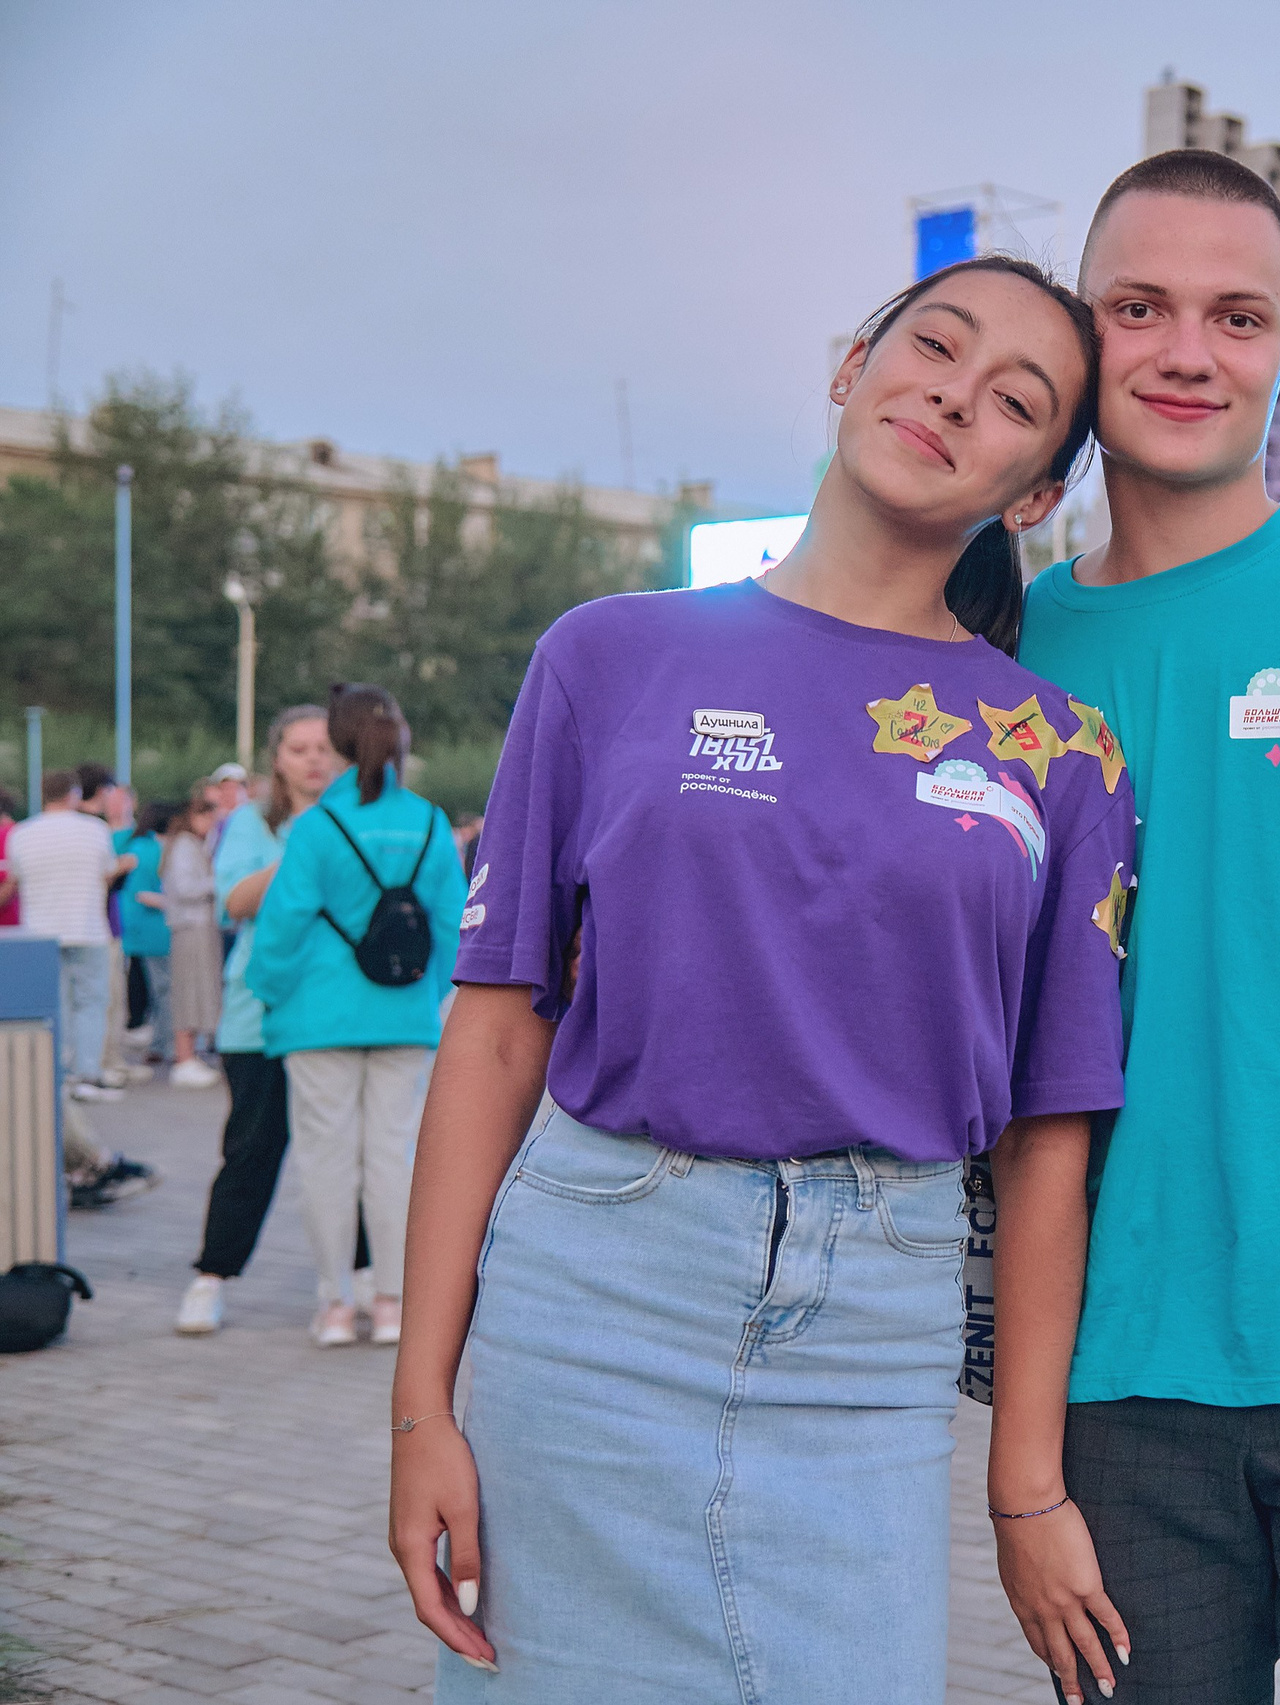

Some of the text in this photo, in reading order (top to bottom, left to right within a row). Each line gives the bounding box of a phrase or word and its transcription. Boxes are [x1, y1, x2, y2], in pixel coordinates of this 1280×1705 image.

[700, 715, 759, 730] Душнила
[681, 773, 731, 784] проект от
[680, 782, 778, 804] росмолодёжь
[930, 789, 984, 802] ПЕРЕМЕНА
[931, 784, 986, 797] БОЛЬШАЯ
